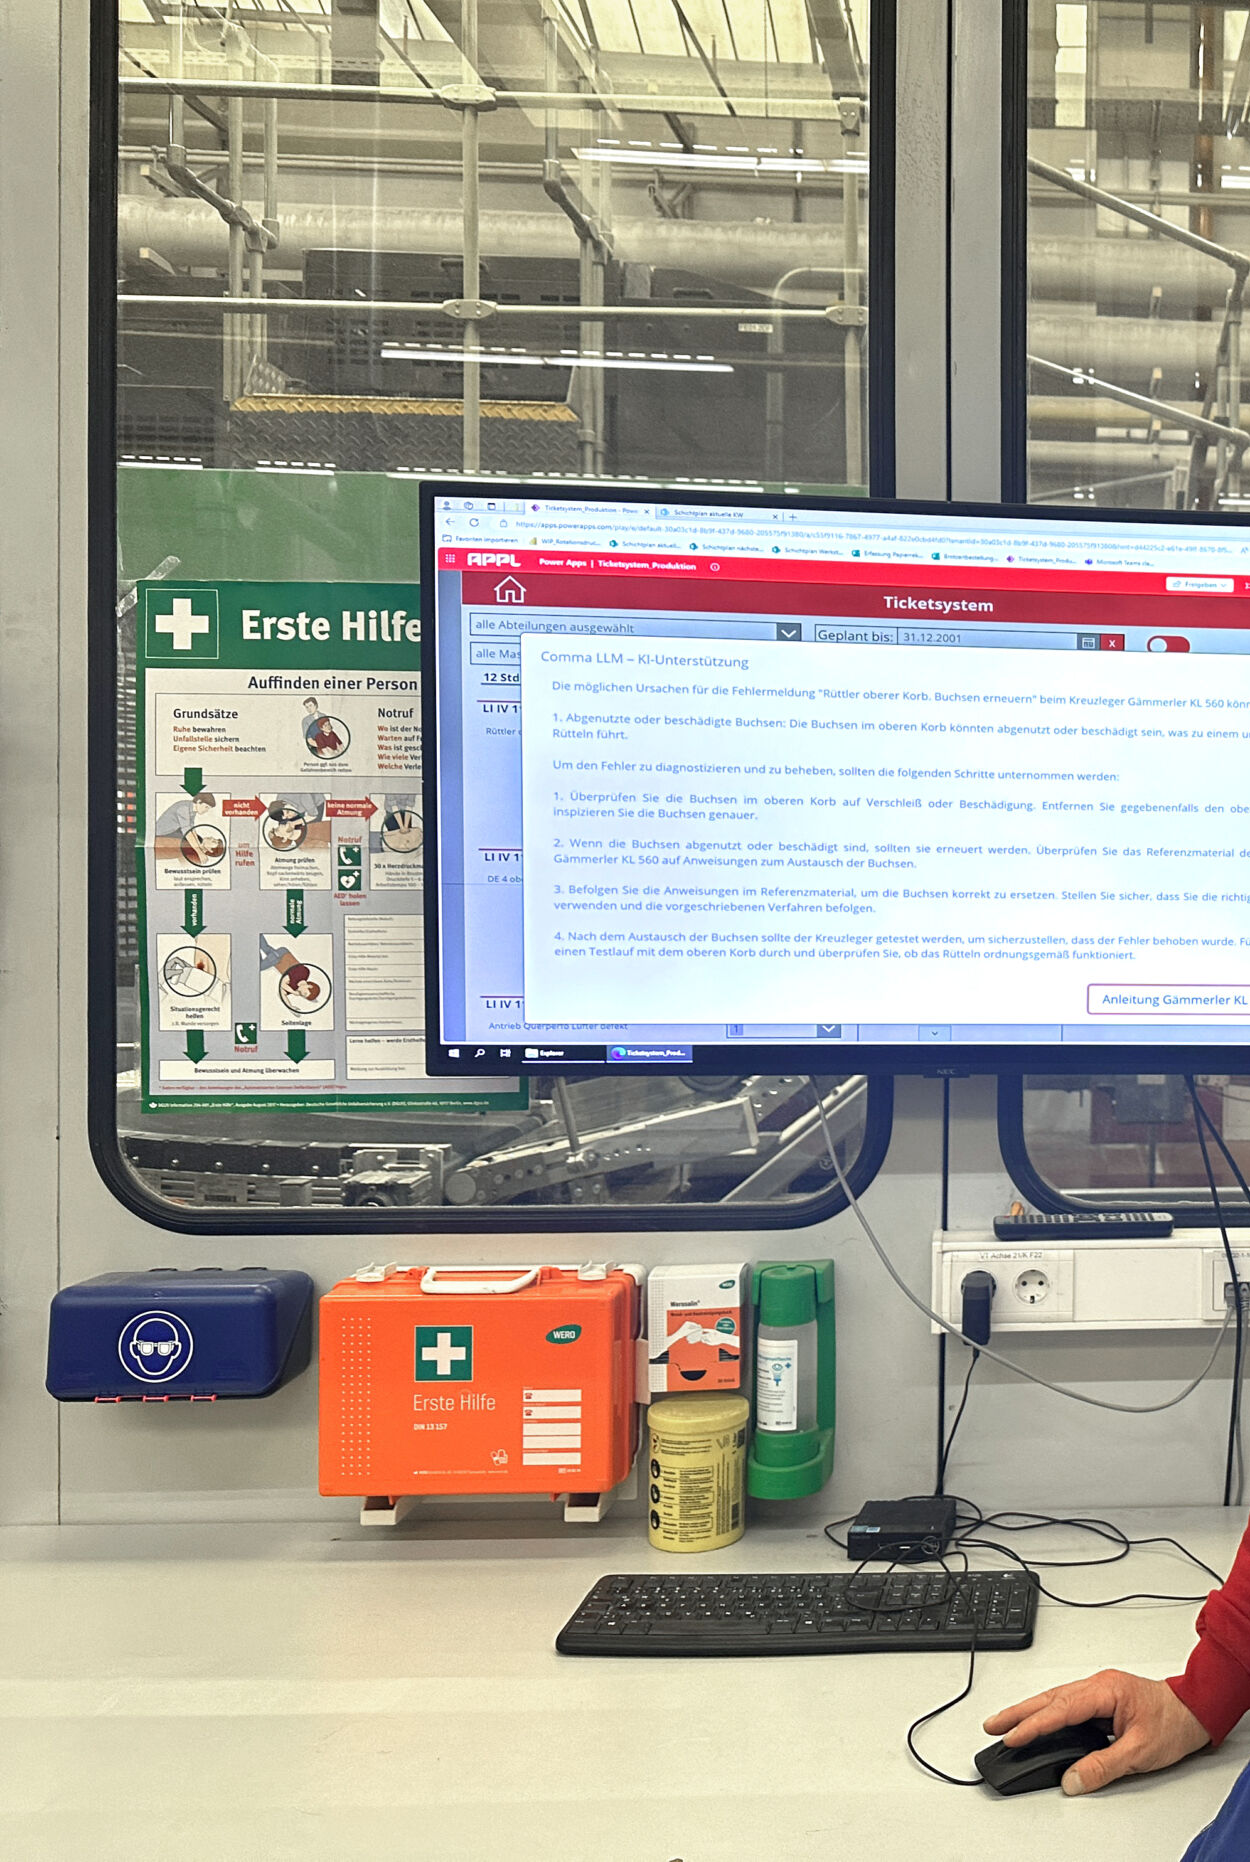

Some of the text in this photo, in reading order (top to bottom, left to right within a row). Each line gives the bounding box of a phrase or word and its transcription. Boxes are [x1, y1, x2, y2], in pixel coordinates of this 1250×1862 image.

[467, 552, 522, 568] APPL
[539, 557, 564, 567] Power
[565, 558, 587, 569] Apps
[598, 559, 697, 572] Ticketsystem_Produktion
[883, 596, 994, 614] Ticketsystem
[242, 609, 422, 643] Erste Hilfe
[475, 619, 635, 635] alle Abteilungen ausgewählt
[818, 629, 962, 644] Geplant bis: 31.12.2001
[475, 648, 521, 660] alle Mas
[540, 650, 593, 664] Comma
[596, 652, 624, 665] LLM
[637, 653, 749, 670] KI-Unterstützung
[248, 676, 418, 691] Auffinden einer Person
[484, 673, 520, 682] 12 Std
[551, 680, 572, 692] Die
[573, 681, 634, 697] möglichen
[635, 682, 690, 696] Ursachen
[691, 683, 710, 696] für
[711, 684, 729, 696] die
[731, 685, 817, 701] Fehlermeldung
[817, 688, 861, 700] "Rüttler
[862, 689, 900, 701] oberer
[902, 691, 932, 702] Korb.
[934, 691, 981, 703] Buchsen
[982, 694, 1038, 705] erneuern"
[1039, 694, 1067, 705] beim
[1069, 695, 1126, 709] Kreuzleger
[1127, 696, 1188, 708] Gämmerler
[1189, 698, 1203, 709] KL
[1205, 698, 1225, 709] 560
[173, 708, 239, 720] Grundsätze
[378, 707, 414, 719] Notruf
[173, 725, 226, 734] Ruhe bewahren
[486, 727, 516, 736] Rüttler
[552, 712, 564, 723] 1.
[565, 712, 631, 726] Abgenutzte
[633, 714, 662, 726] oder
[663, 714, 733, 729] beschädigte
[735, 716, 787, 729] Buchsen:
[789, 717, 809, 729] Die
[810, 719, 859, 731] Buchsen
[861, 720, 876, 731] im
[878, 720, 918, 733] oberen
[920, 721, 947, 733] Korb
[949, 722, 995, 734] könnten
[996, 724, 1051, 737] abgenutzt
[1053, 725, 1079, 736] oder
[1081, 725, 1139, 739] beschädigt
[1140, 727, 1166, 738] sein,
[1167, 729, 1189, 738] was
[1191, 730, 1204, 739] zu
[1206, 730, 1240, 739] einem
[173, 735, 240, 743] Unfallstelle sichern
[377, 735, 416, 743] Warten auf
[552, 727, 629, 741] Rütteln führt.
[173, 744, 266, 754] Eigene Sicherheit beachten
[377, 744, 392, 752] Was
[393, 744, 403, 752] ist
[377, 754, 391, 762] Wie
[392, 754, 409, 762] viele
[377, 763, 403, 771] Welche
[552, 759, 1120, 782] Um den Fehler zu diagnostizieren und zu beheben, sollten die folgenden Schritte unternommen werden:
[235, 850, 254, 858] Hilfe
[235, 859, 256, 867] rufen
[190, 893, 198, 927] vorhanden
[1102, 993, 1160, 1008] Anleitung
[1162, 994, 1231, 1006] Gämmerler
[1233, 995, 1249, 1006] KL
[234, 1045, 259, 1053] Notruf
[553, 1330, 576, 1340] WERO
[413, 1393, 496, 1412] Erste Hilfe
[413, 1423, 426, 1431] DIN
